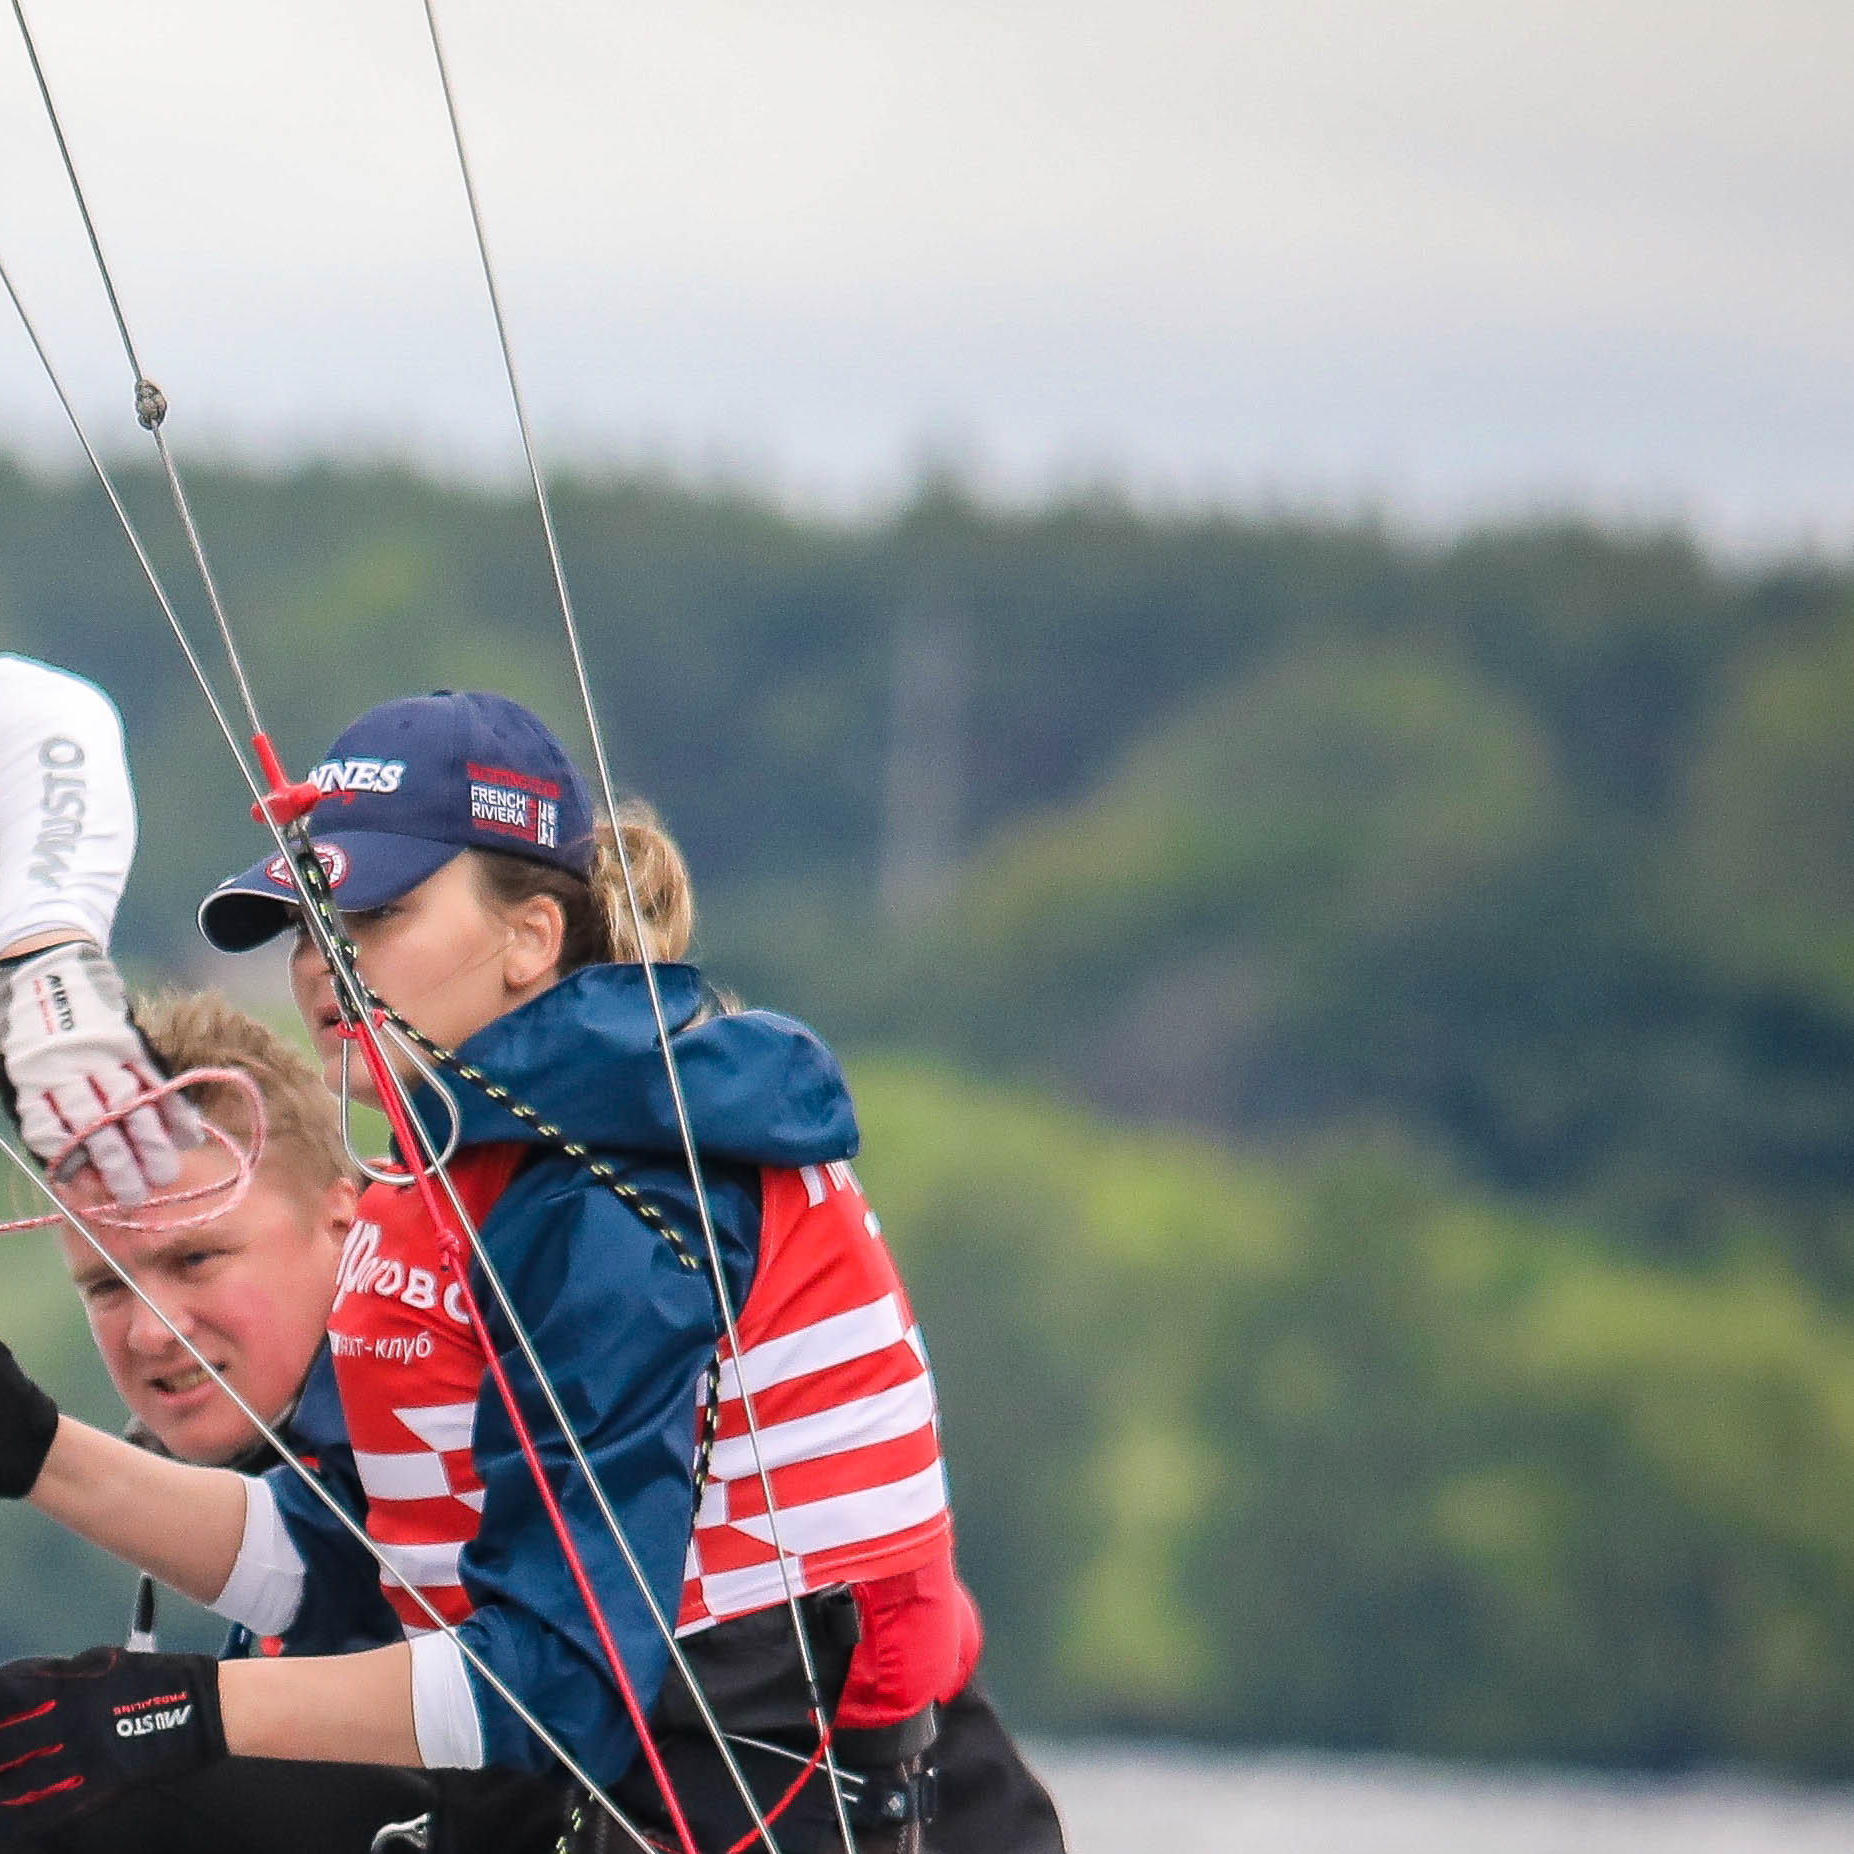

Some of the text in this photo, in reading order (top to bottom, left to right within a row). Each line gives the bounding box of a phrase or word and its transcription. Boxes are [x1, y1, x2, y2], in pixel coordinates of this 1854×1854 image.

[28, 736, 85, 890] MUSTO
[470, 784, 526, 812] FRENCH
[471, 802, 526, 828] RIVIERA
[116, 1704, 192, 1737] MUSTO
